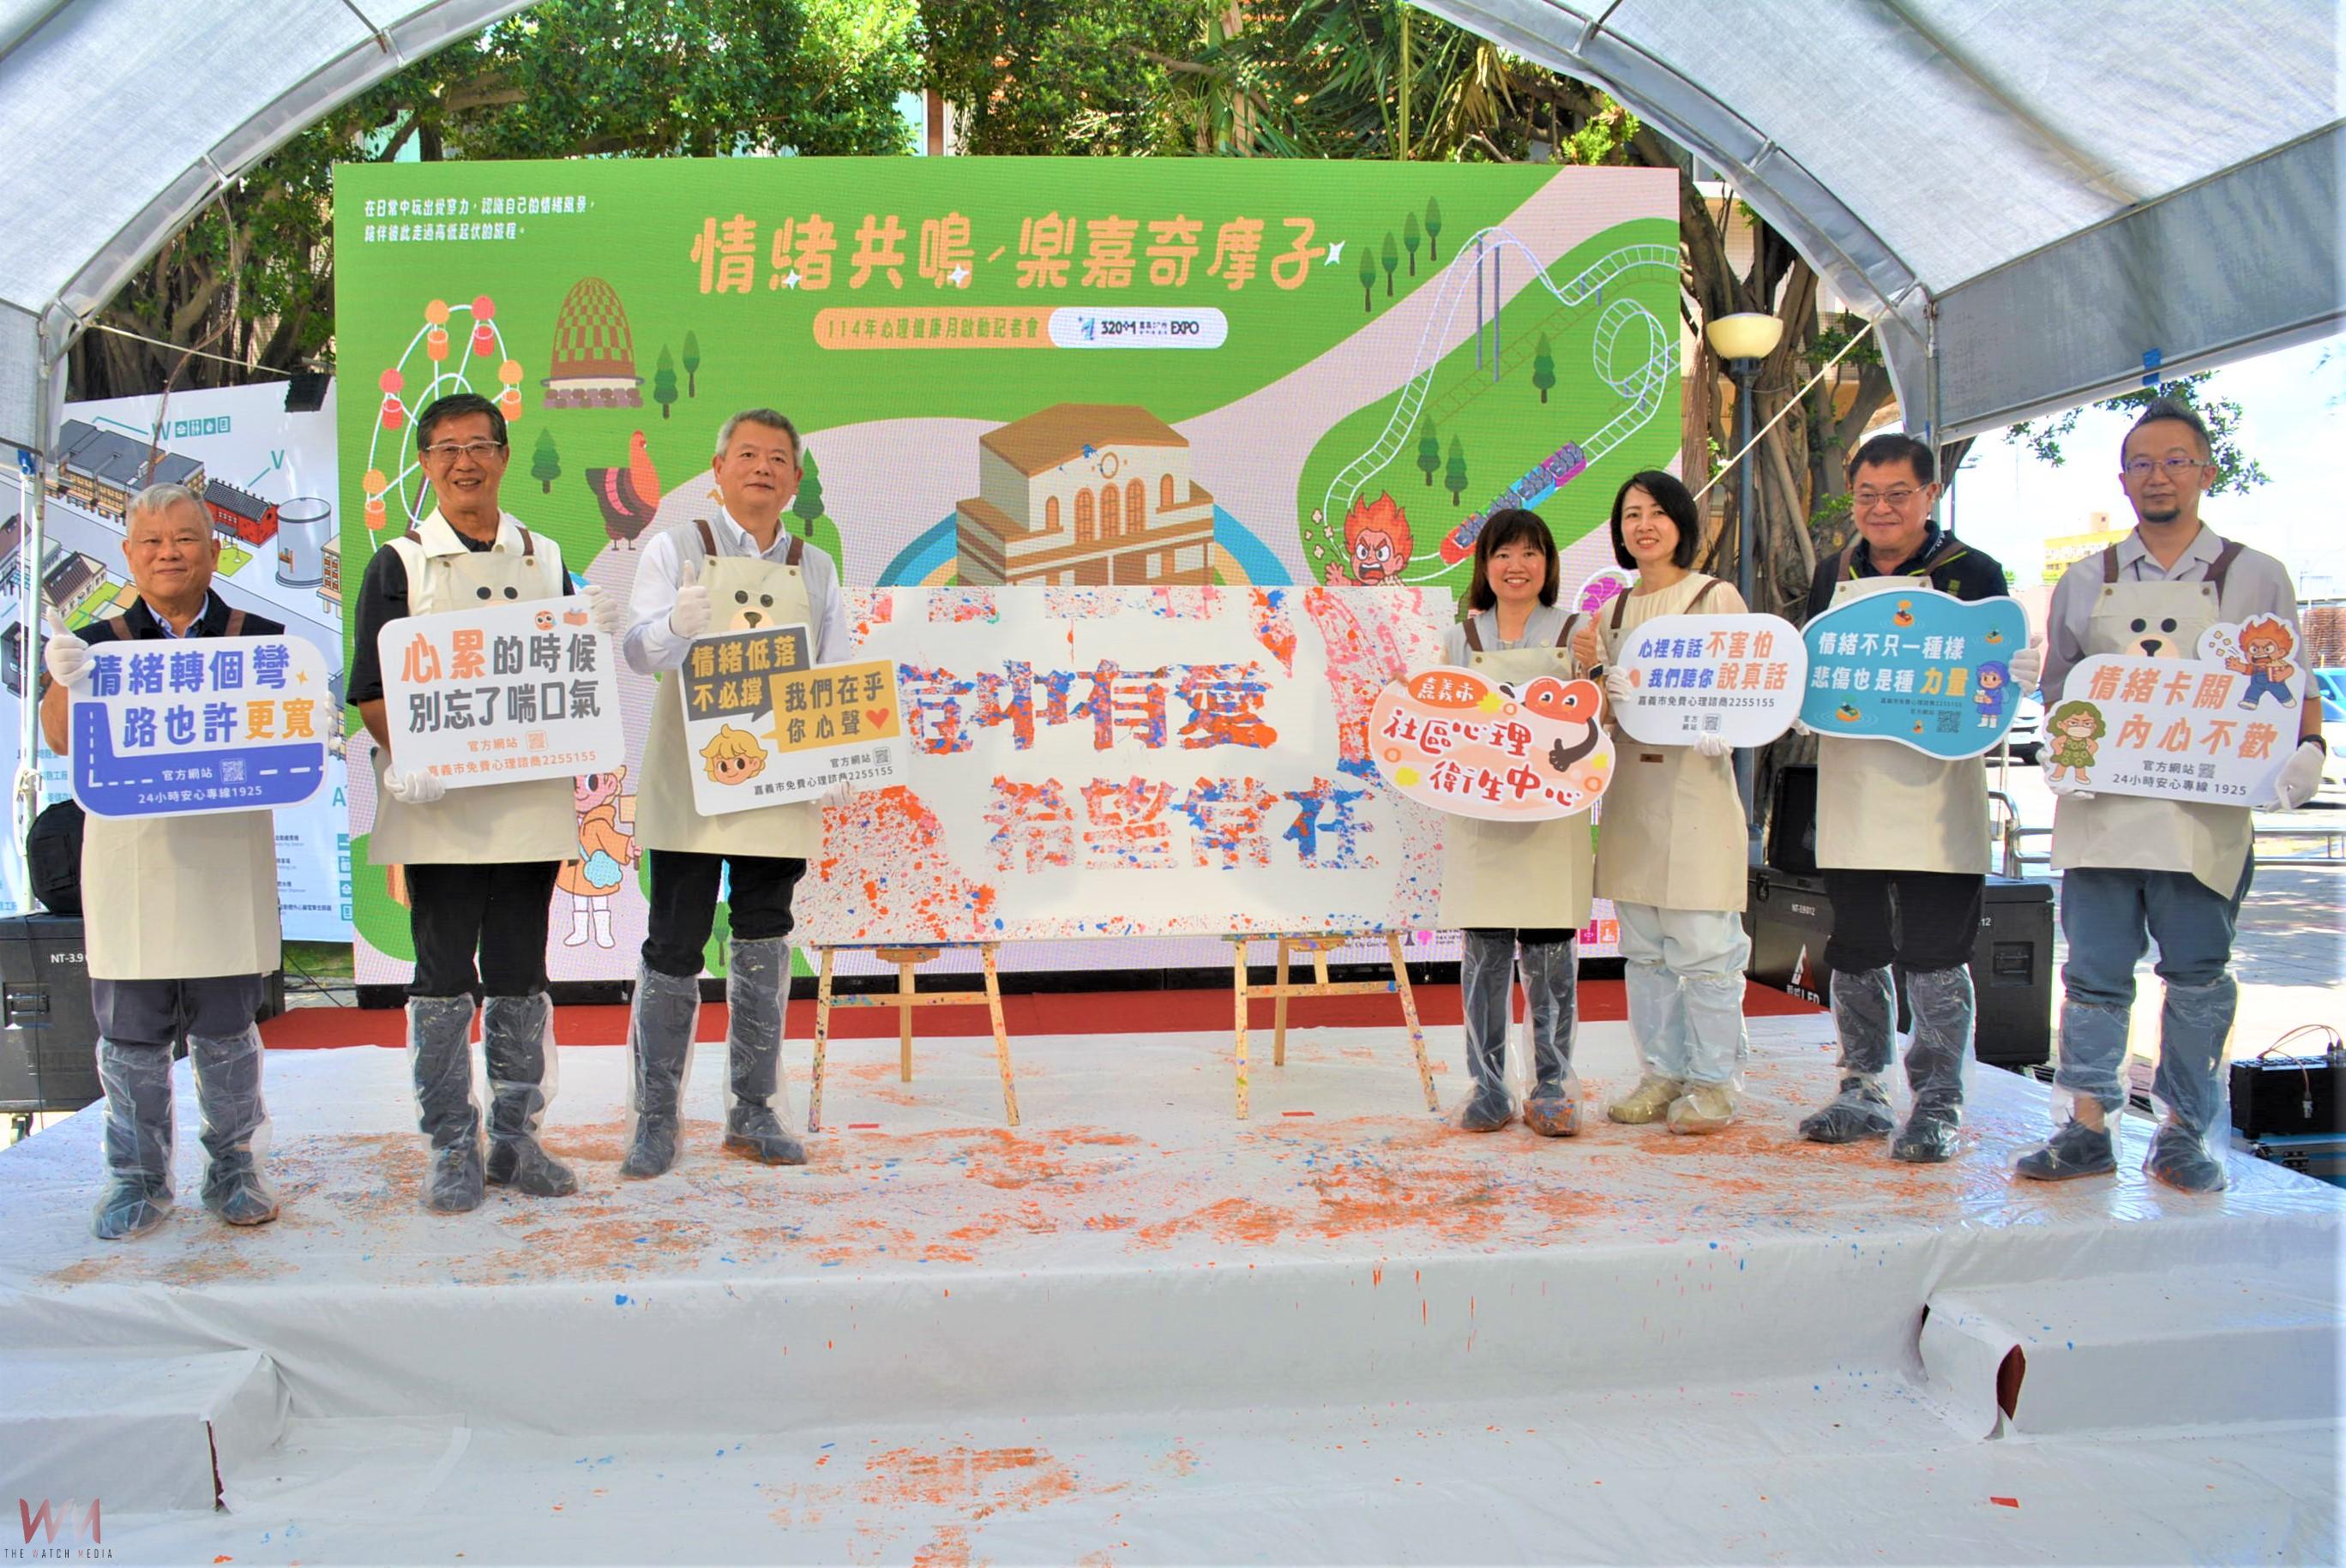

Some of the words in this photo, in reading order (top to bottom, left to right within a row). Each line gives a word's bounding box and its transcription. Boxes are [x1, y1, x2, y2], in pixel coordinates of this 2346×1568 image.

[1170, 321, 1200, 334] EXPO
[270, 449, 285, 469] V
[400, 628, 598, 684] 心累的時候
[691, 634, 797, 679] 情緒低落
[1705, 630, 1774, 659] 不害怕
[1818, 631, 1966, 661] 情緒不只一種樣
[87, 643, 291, 698] 情緒轉個彎
[1648, 668, 1714, 688] 我們聽你
[1717, 662, 1789, 690] 說真話
[1811, 665, 1916, 694] 悲傷也是種
[1920, 667, 1969, 697] 力量
[693, 676, 763, 712] 不必撐
[785, 670, 884, 713] 我們在乎
[1417, 676, 1475, 702] 嘉義市
[1638, 695, 1775, 707] 嘉義市免費心理諮商2255155
[2088, 664, 2235, 710] 情緒卡關
[408, 679, 600, 734] 別忘了喘口氣
[123, 700, 238, 749] 路也許
[244, 697, 316, 741] 更寬
[786, 709, 860, 744] 你心聲
[1383, 709, 1532, 757] 社區心理
[2115, 713, 2277, 760] 內心不歡
[467, 737, 519, 753] 官方網站
[830, 753, 871, 768] 官方網站
[161, 767, 214, 782] 官方網站
[1429, 760, 1581, 807] 衛生中心
[2143, 760, 2195, 775] 官方網站
[138, 784, 262, 805] 24小時安心專線1925
[2113, 773, 2209, 792] 24小時安心專線
[2215, 784, 2247, 796] 1925
[983, 774, 1379, 873] 希望常在
